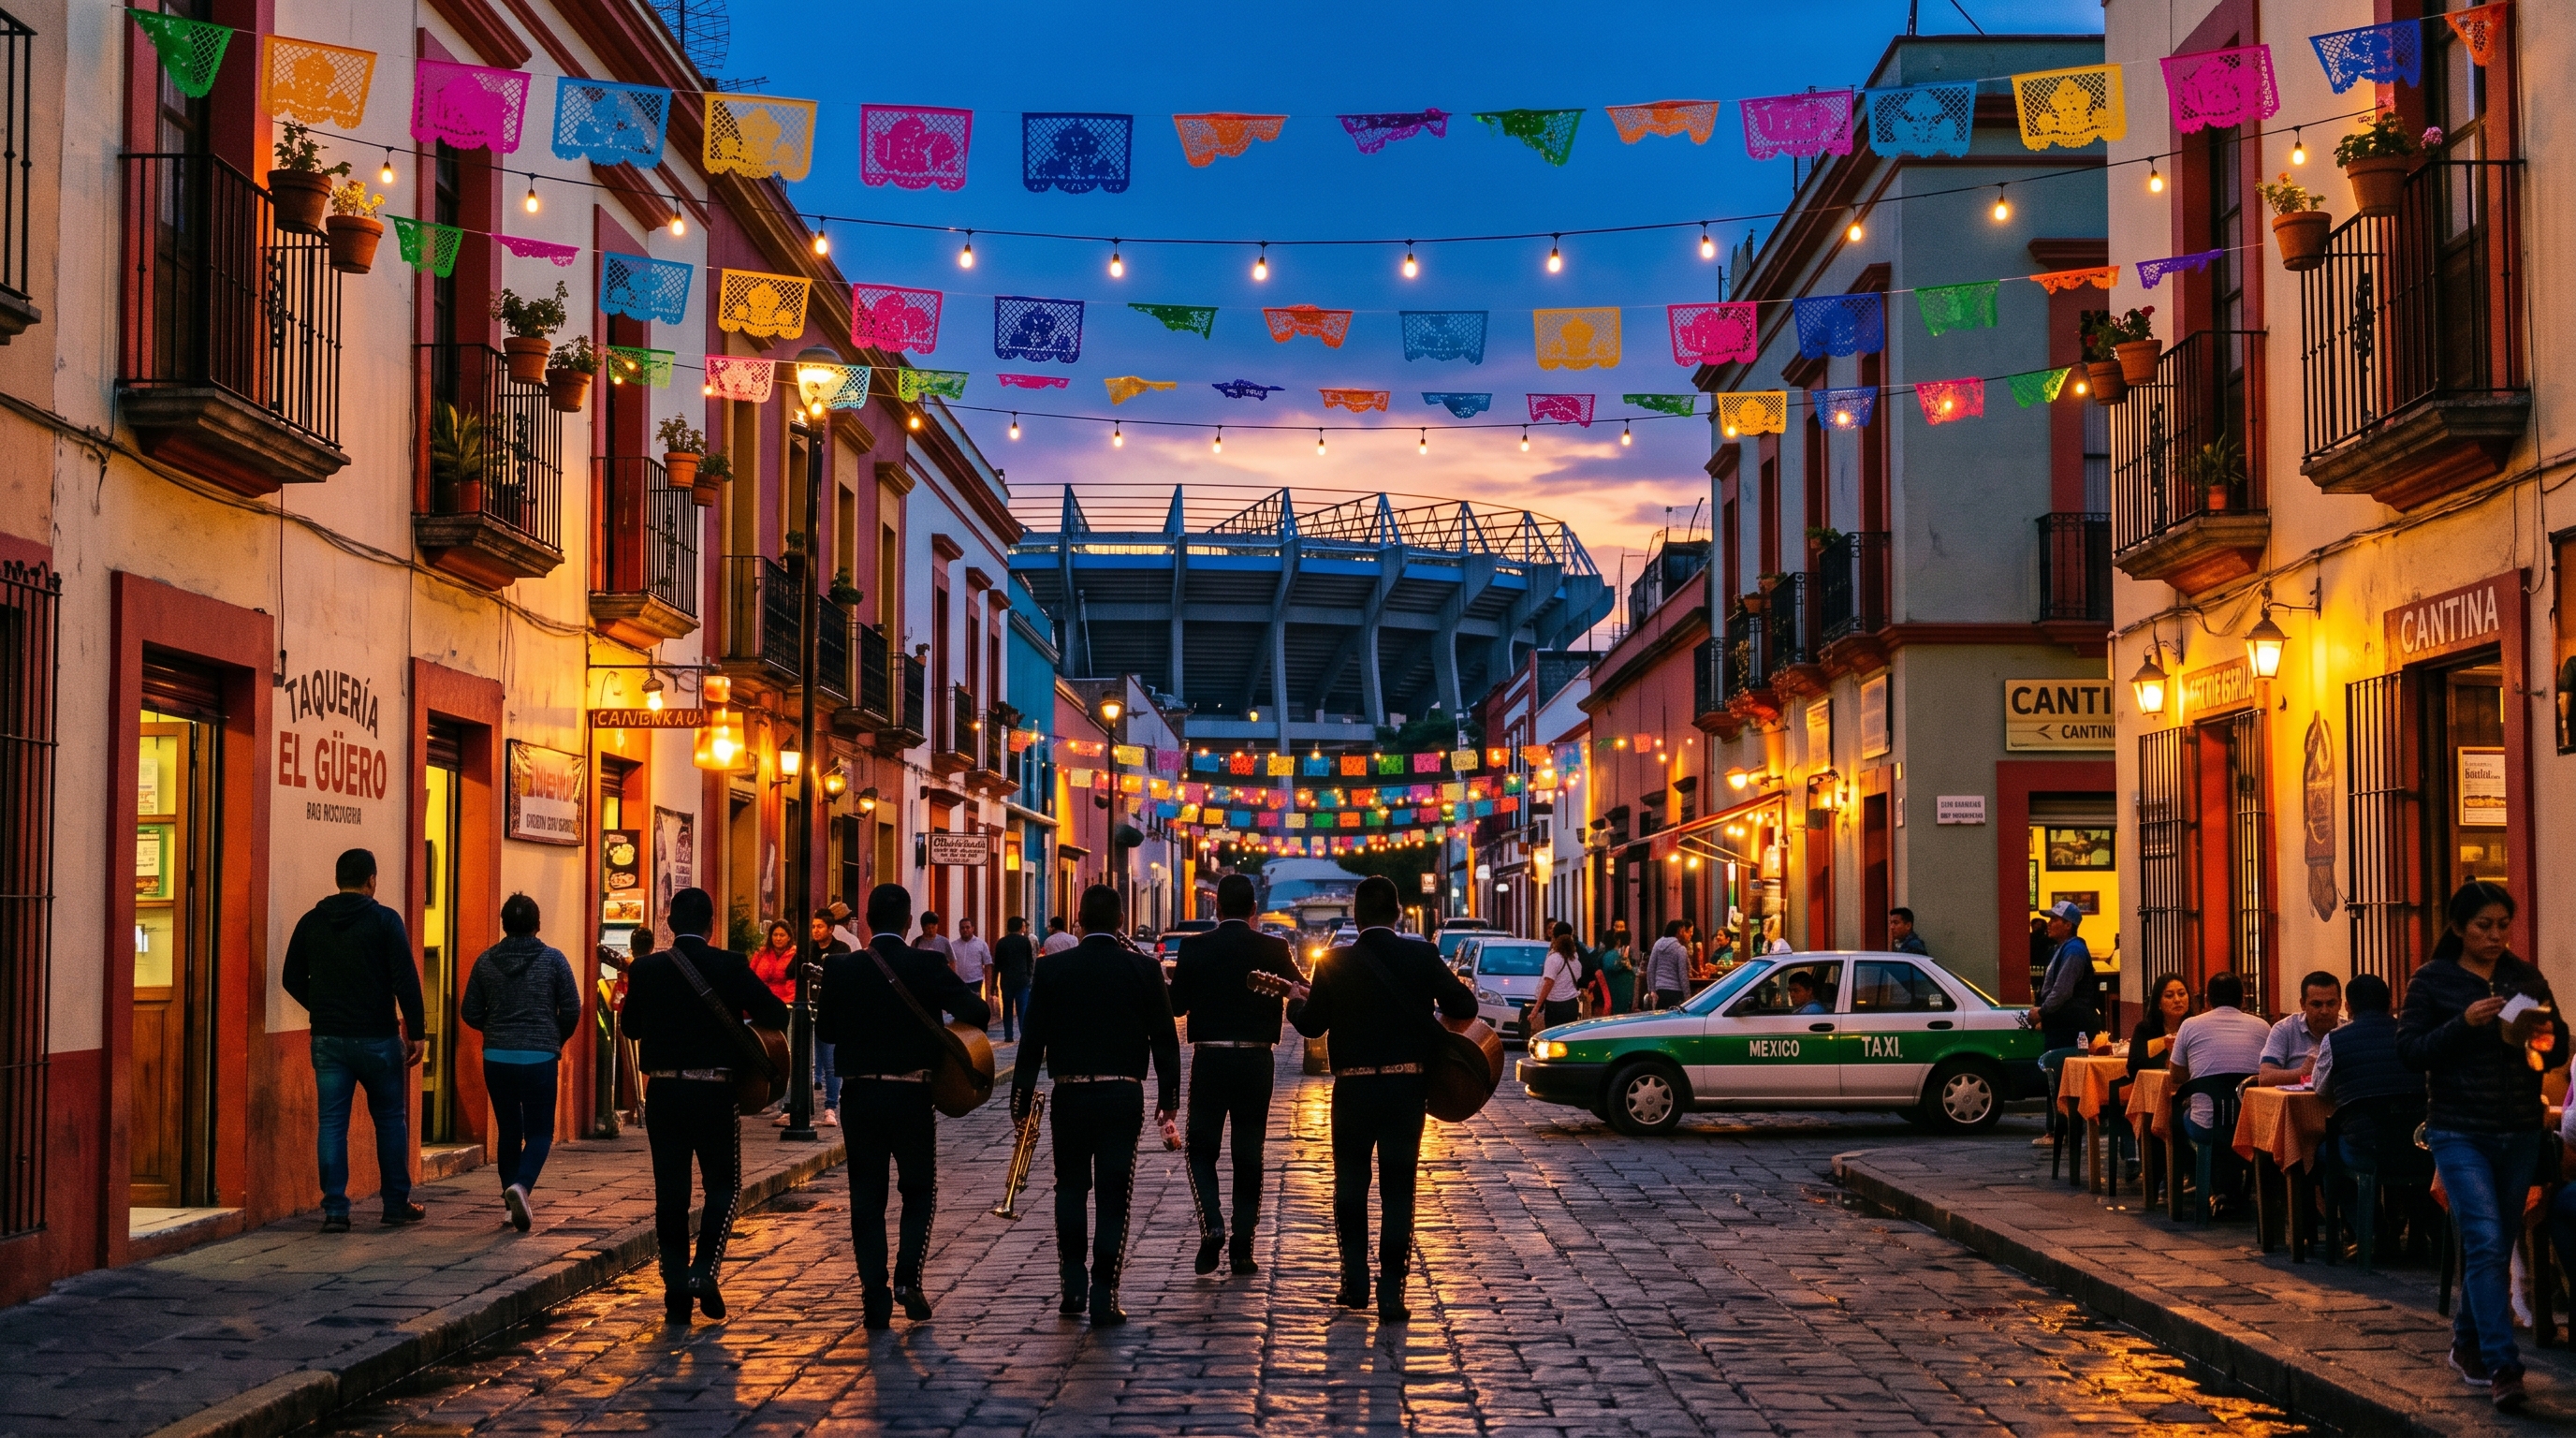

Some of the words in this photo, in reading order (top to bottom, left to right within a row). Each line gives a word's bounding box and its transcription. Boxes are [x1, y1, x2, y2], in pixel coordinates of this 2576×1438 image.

[2401, 585, 2499, 653] CANTINA
[285, 669, 378, 741] TAQUERÍA
[2012, 686, 2111, 715] CANTI
[279, 730, 307, 788] EL
[315, 730, 387, 800] GÜERO
[1749, 1040, 1800, 1057] MEXICO
[1861, 1036, 1899, 1057] TAXI
